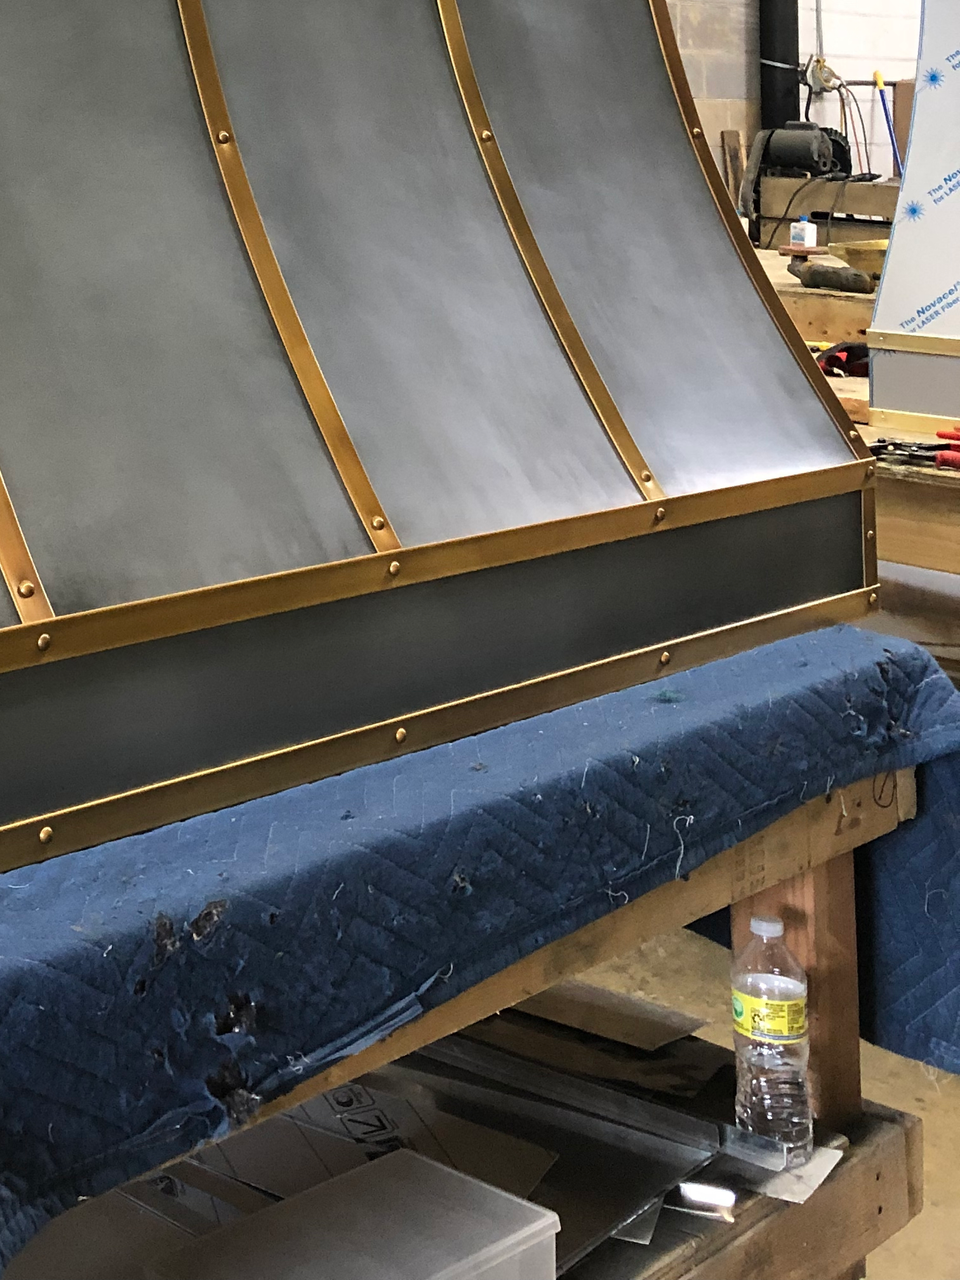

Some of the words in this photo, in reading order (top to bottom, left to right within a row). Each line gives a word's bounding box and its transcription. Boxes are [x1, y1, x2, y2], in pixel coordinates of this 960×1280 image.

[926, 184, 944, 197] The
[933, 194, 945, 205] for
[899, 316, 917, 329] The
[916, 309, 942, 329] LASER
